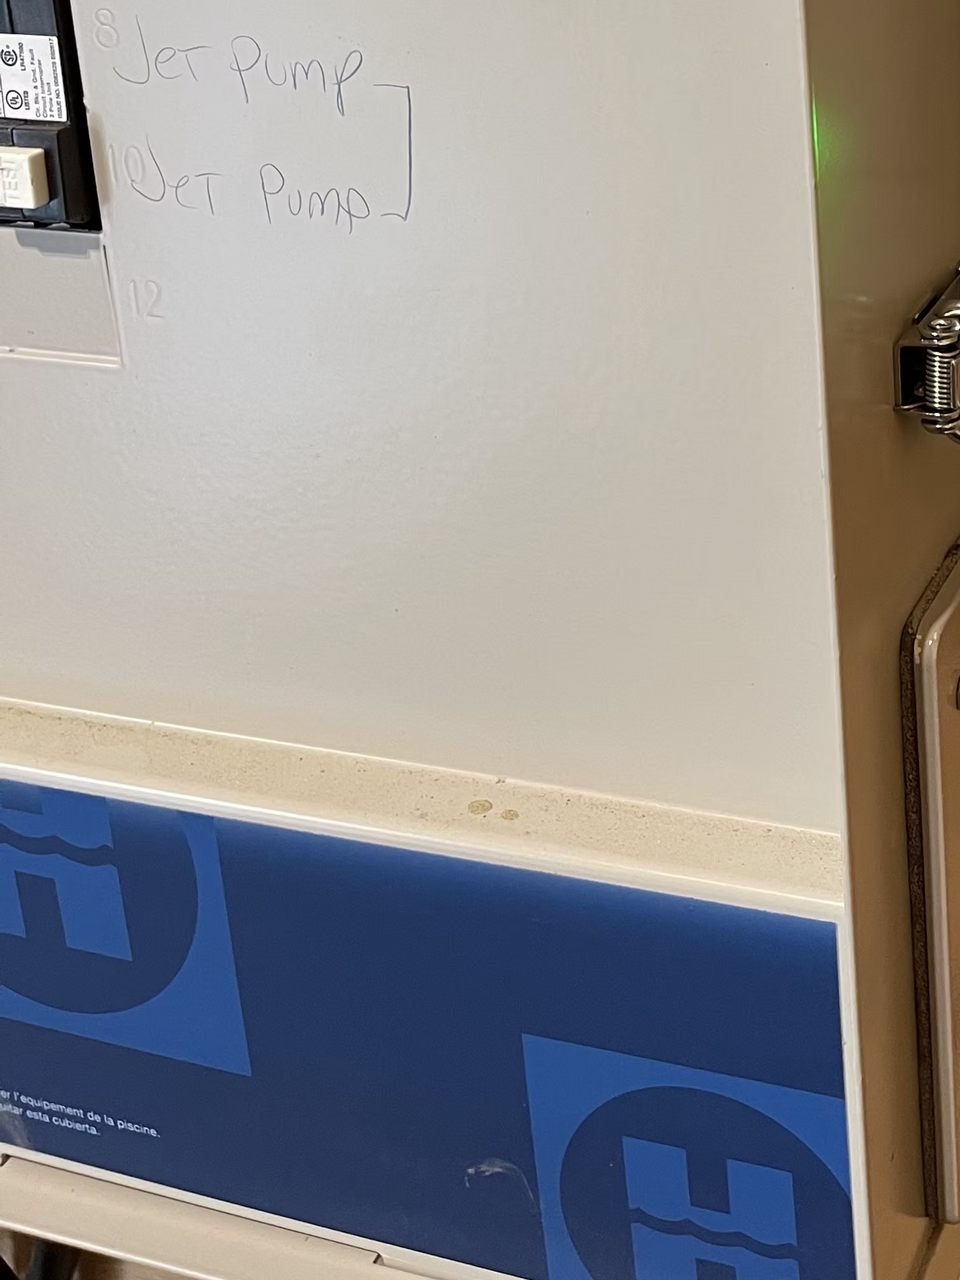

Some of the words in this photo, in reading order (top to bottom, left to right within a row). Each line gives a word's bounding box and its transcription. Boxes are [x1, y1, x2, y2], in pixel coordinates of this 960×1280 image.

[94, 8, 118, 48] 8
[40, 96, 48, 118] Circuit
[1, 156, 20, 203] TEST
[128, 279, 163, 318] 12
[26, 1109, 50, 1123] esta
[52, 1116, 101, 1136] cubierta.
[87, 1111, 102, 1122] de
[104, 1114, 115, 1127] la
[117, 1119, 161, 1138] piscine.
